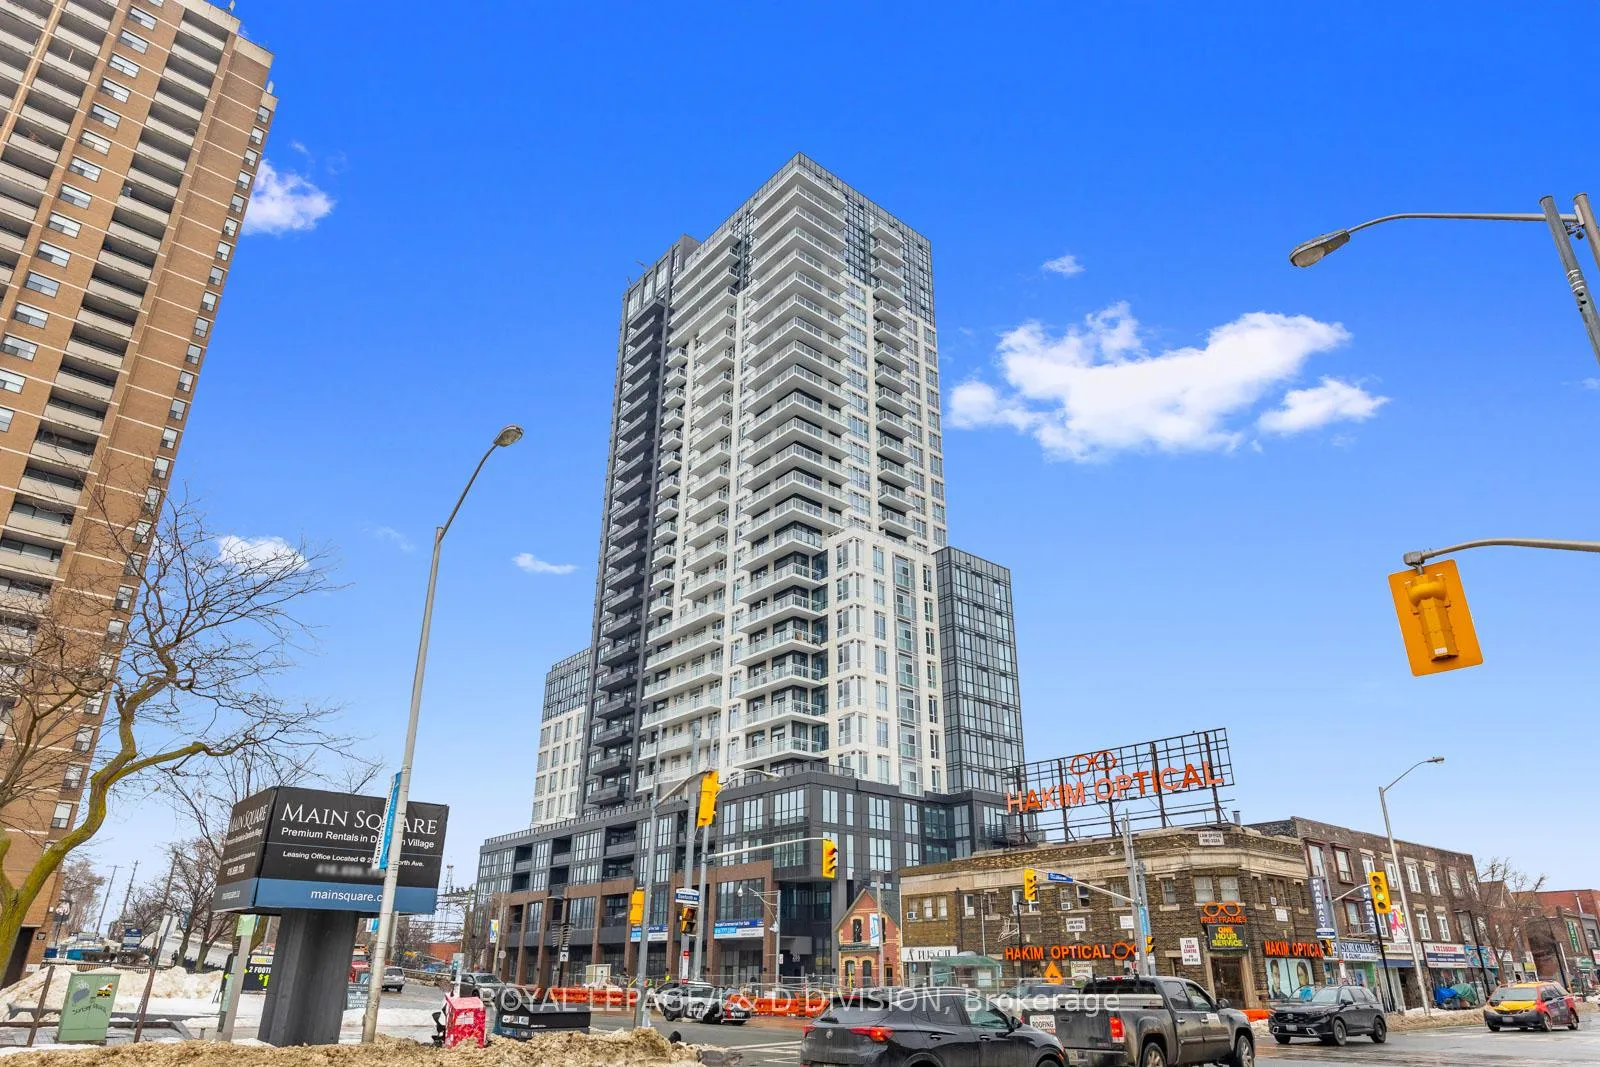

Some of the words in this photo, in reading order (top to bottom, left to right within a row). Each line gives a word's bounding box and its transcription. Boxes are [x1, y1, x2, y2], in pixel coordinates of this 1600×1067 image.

[1007, 781, 1086, 814] HAKIM
[1094, 760, 1224, 800] OPTICAL
[280, 803, 349, 826] MAIN
[354, 810, 438, 835] SQARE
[281, 827, 323, 838] Premium
[325, 831, 359, 841] Rentals
[360, 834, 368, 842] in
[407, 838, 435, 849] Village
[282, 851, 309, 859] Leasing
[311, 852, 331, 860] Office
[332, 854, 358, 862] Located
[310, 889, 383, 902] mainsquare.c
[1312, 879, 1327, 928] PHARMACY
[1201, 916, 1216, 924] FREE
[1218, 915, 1247, 924] FRAMES
[1211, 939, 1243, 947] SERVICE
[1264, 940, 1289, 956] HAKIM
[1291, 942, 1324, 957] OPTICA
[1005, 945, 1044, 960] HAKIM
[1050, 944, 1111, 959] OPTICAL
